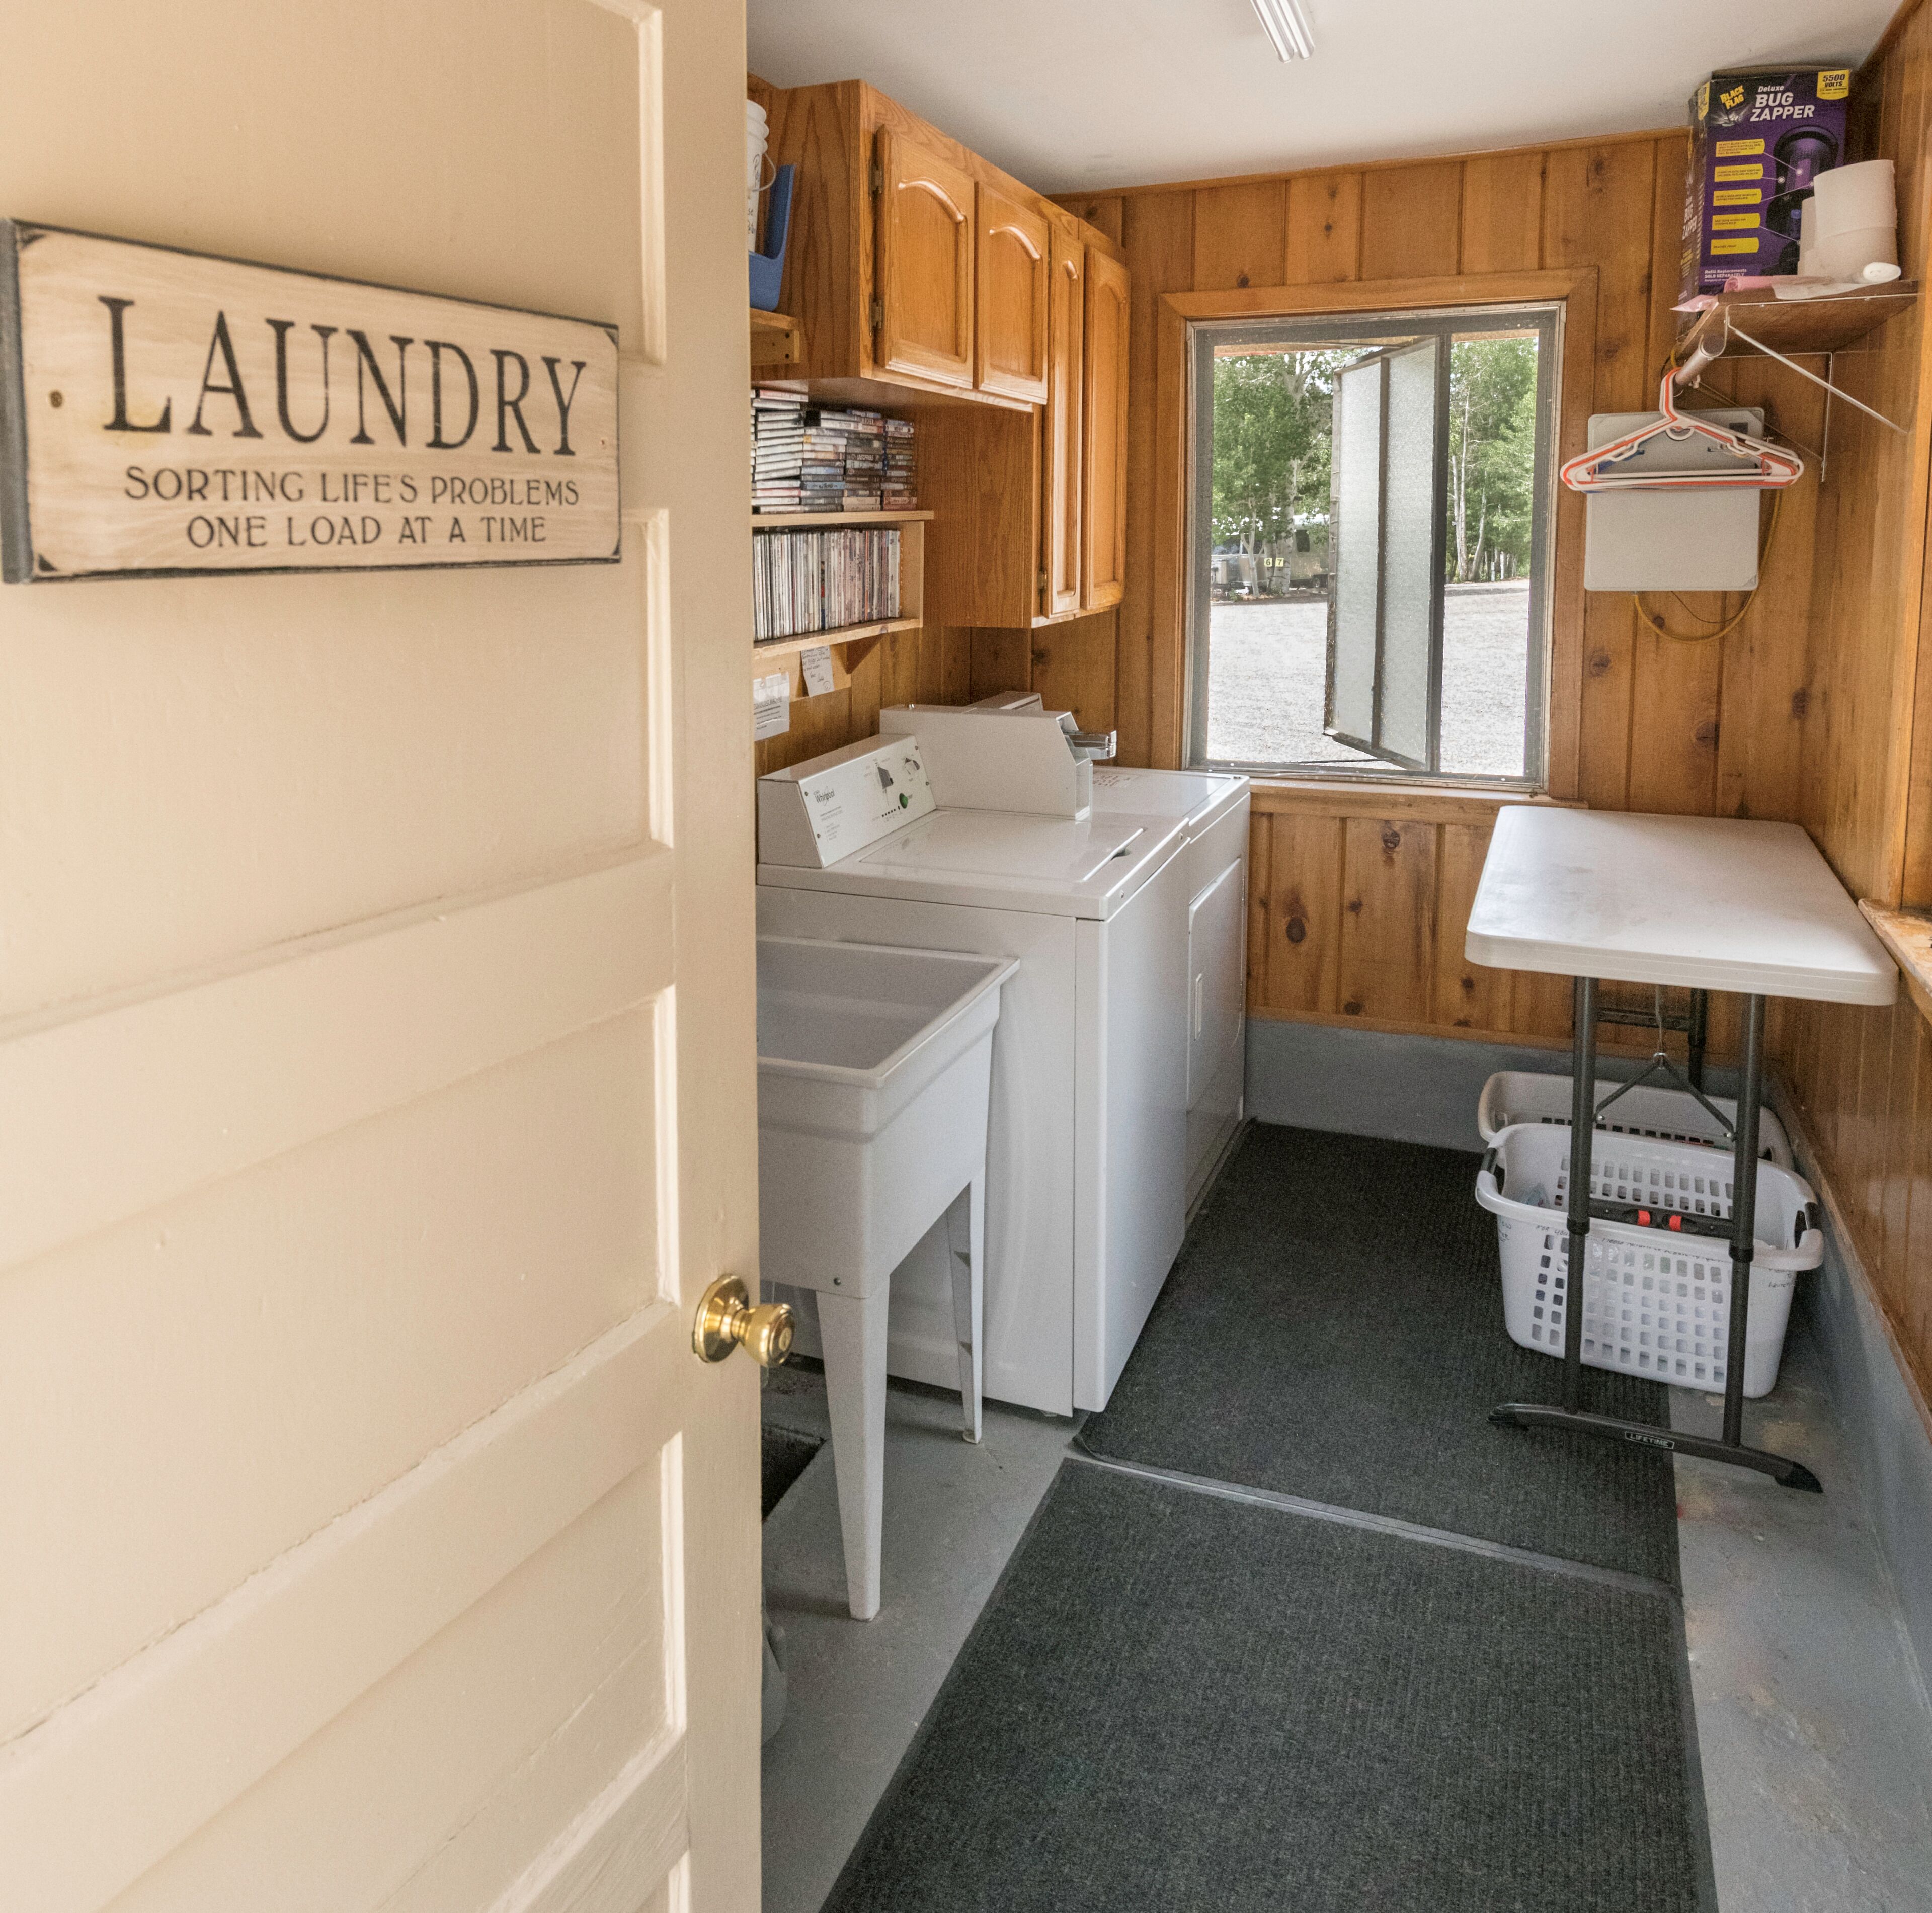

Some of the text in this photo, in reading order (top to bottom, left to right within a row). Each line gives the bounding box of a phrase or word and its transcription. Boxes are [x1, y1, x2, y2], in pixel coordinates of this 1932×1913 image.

[1823, 74, 1845, 82] 5500
[1720, 85, 1744, 103] BLACK
[1725, 94, 1744, 109] FLAG
[1755, 92, 1794, 107] BUG
[1750, 105, 1815, 122] ZAPPER
[98, 295, 587, 456] LAUNDRY
[124, 466, 304, 504] SORTING
[432, 476, 579, 507] PROBLEMS
[187, 516, 547, 549] ONE LOAD AT A TIME
[815, 788, 835, 803] Whirlpool
[1630, 1433, 1668, 1447] LIFETIME
